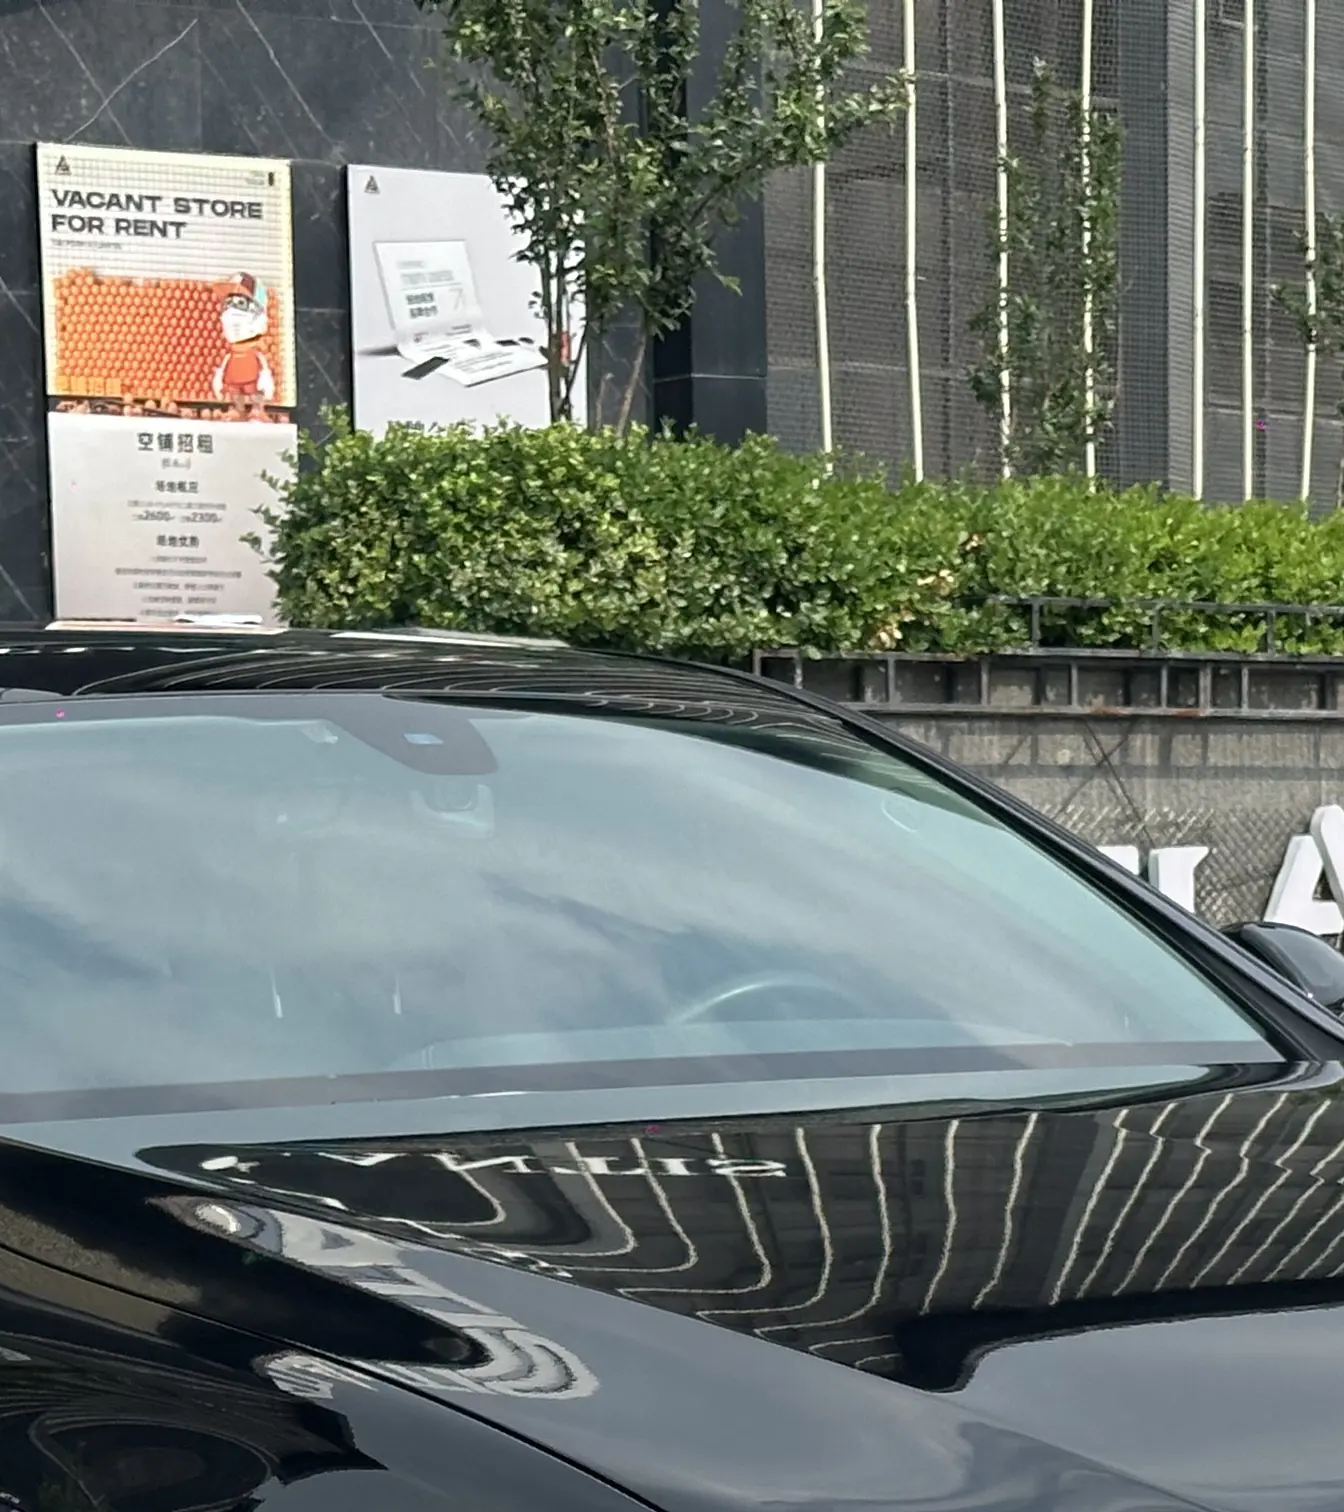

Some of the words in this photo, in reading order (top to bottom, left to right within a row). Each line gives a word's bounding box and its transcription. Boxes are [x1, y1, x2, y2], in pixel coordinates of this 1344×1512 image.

[52, 188, 162, 213] VACANT
[173, 197, 263, 219] STORE
[52, 213, 104, 234] FOR
[115, 218, 187, 240] RENT
